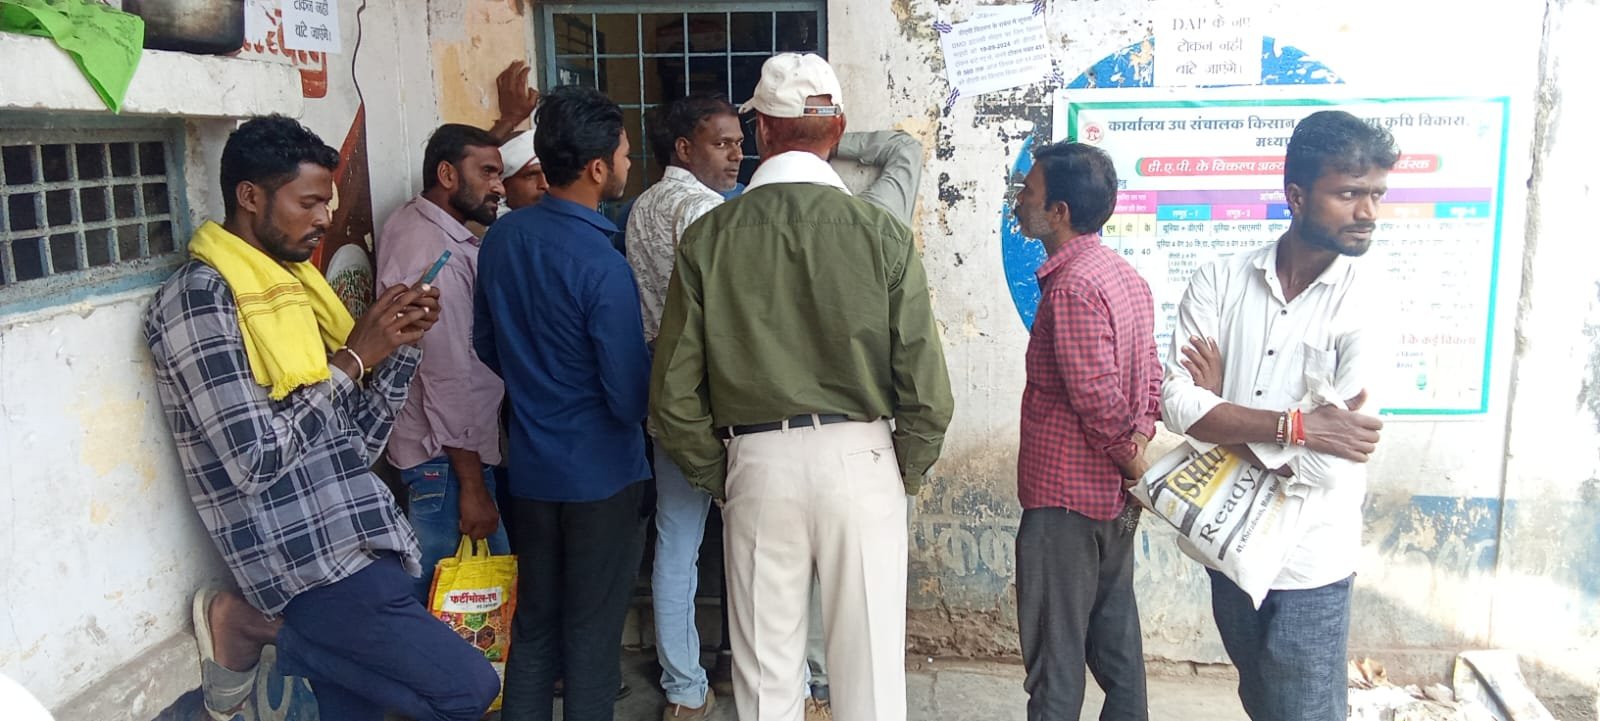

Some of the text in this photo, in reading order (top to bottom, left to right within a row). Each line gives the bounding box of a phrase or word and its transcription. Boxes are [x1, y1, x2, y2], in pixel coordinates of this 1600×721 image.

[1172, 17, 1206, 30] DAP
[1212, 14, 1225, 28] के
[1177, 36, 1243, 52] टोकन नहीं
[1108, 116, 1166, 132] कार्यालय
[1168, 119, 1186, 131] उप
[1190, 115, 1244, 131] संचालक
[1248, 115, 1295, 130] किसान
[1196, 160, 1208, 172] के
[1211, 159, 1255, 172] विकल्प
[1141, 248, 1151, 256] 40
